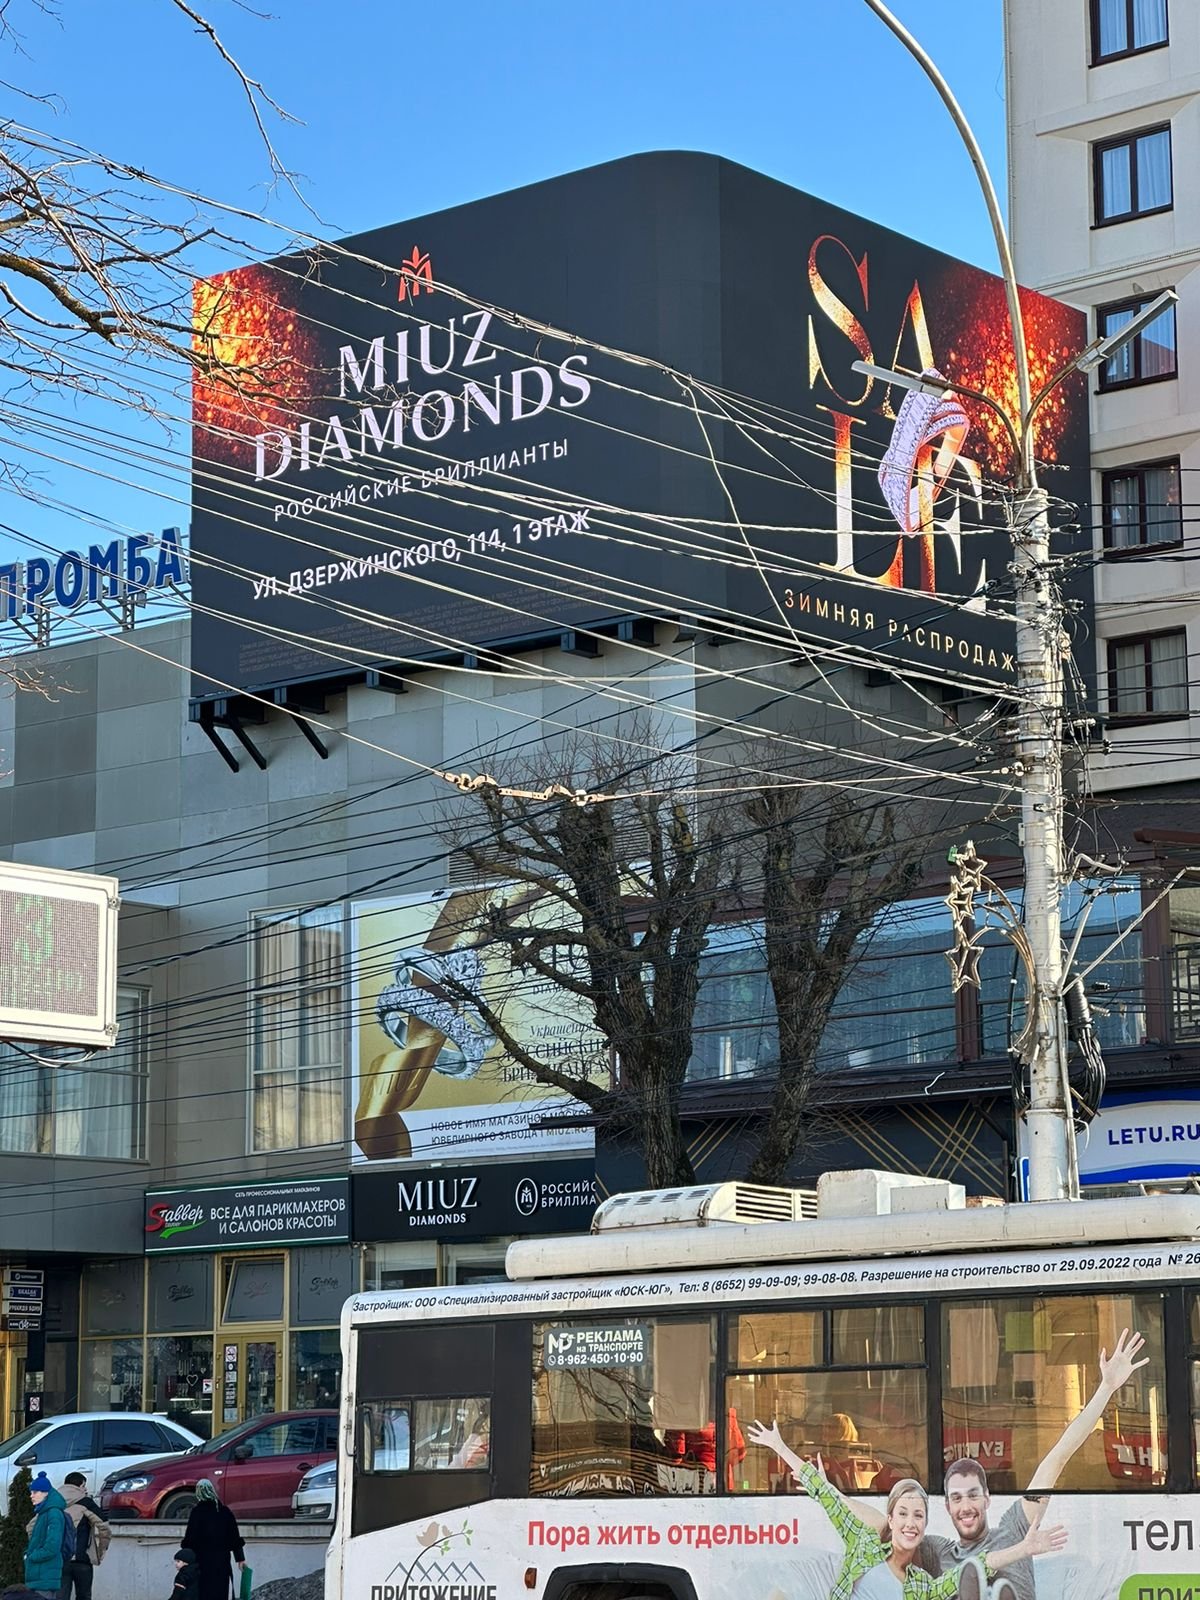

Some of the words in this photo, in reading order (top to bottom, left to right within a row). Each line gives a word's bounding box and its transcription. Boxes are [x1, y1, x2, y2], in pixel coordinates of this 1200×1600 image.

[340, 309, 498, 398] MIUZ
[255, 355, 592, 482] DIAMONDS
[274, 474, 413, 522] РОССИЙСКИЕ
[421, 438, 569, 489] БРИЛЛИАНТЫ
[252, 575, 283, 601] УЛ.
[287, 537, 463, 597] ДЗЕРЖИНСКОГО,
[467, 528, 508, 553] 114,
[512, 522, 522, 545] 1
[527, 508, 593, 542] ЭТАЖ
[0, 526, 192, 622] ПРОМБА
[784, 588, 875, 631] ЗИМНЯЯ
[888, 618, 1017, 673] РАСПРОДАЖ
[431, 1118, 464, 1132] НОВОЕ
[465, 1117, 486, 1129] ИМЯ
[1107, 1123, 1200, 1146] LETU.RU
[210, 1207, 231, 1220] ВСЕ
[231, 1204, 256, 1220] ДЛЯ
[257, 1198, 346, 1217] ПАРИКМАХЕРОВ
[397, 1177, 478, 1212] MIUZ
[219, 1222, 227, 1235] И
[228, 1218, 284, 1234] САЛОНОВ
[286, 1214, 337, 1230] КРАСОТЫ
[409, 1212, 467, 1226] DIAMONDS
[353, 1299, 413, 1313] Застройщик:
[415, 1297, 437, 1308] ООО
[438, 1290, 550, 1308] «Специализированный
[551, 1286, 613, 1302] застройщик
[614, 1282, 673, 1297] «ЮСК-ЮГ»,
[679, 1282, 700, 1294] Тел:
[702, 1281, 710, 1292] 8
[711, 1279, 746, 1294] (8652)
[748, 1275, 801, 1290] 99-09-09;
[803, 1271, 858, 1286] 99-08-08.
[860, 1270, 932, 1284] Разрешение
[934, 1267, 949, 1278] на
[951, 1262, 1041, 1279] строительство
[1043, 1262, 1057, 1273] от
[1059, 1256, 1131, 1272] 29.09.2022
[1132, 1257, 1162, 1269] года
[1168, 1253, 1183, 1266] №
[576, 1329, 644, 1344] РЕКЛАМА
[576, 1345, 587, 1353] на
[588, 1341, 644, 1353] ТРАНСПОРТЕ
[527, 1520, 590, 1553] Пора
[596, 1524, 661, 1546] жить
[667, 1517, 800, 1550] отдельно!
[1122, 1519, 1200, 1552] тел
